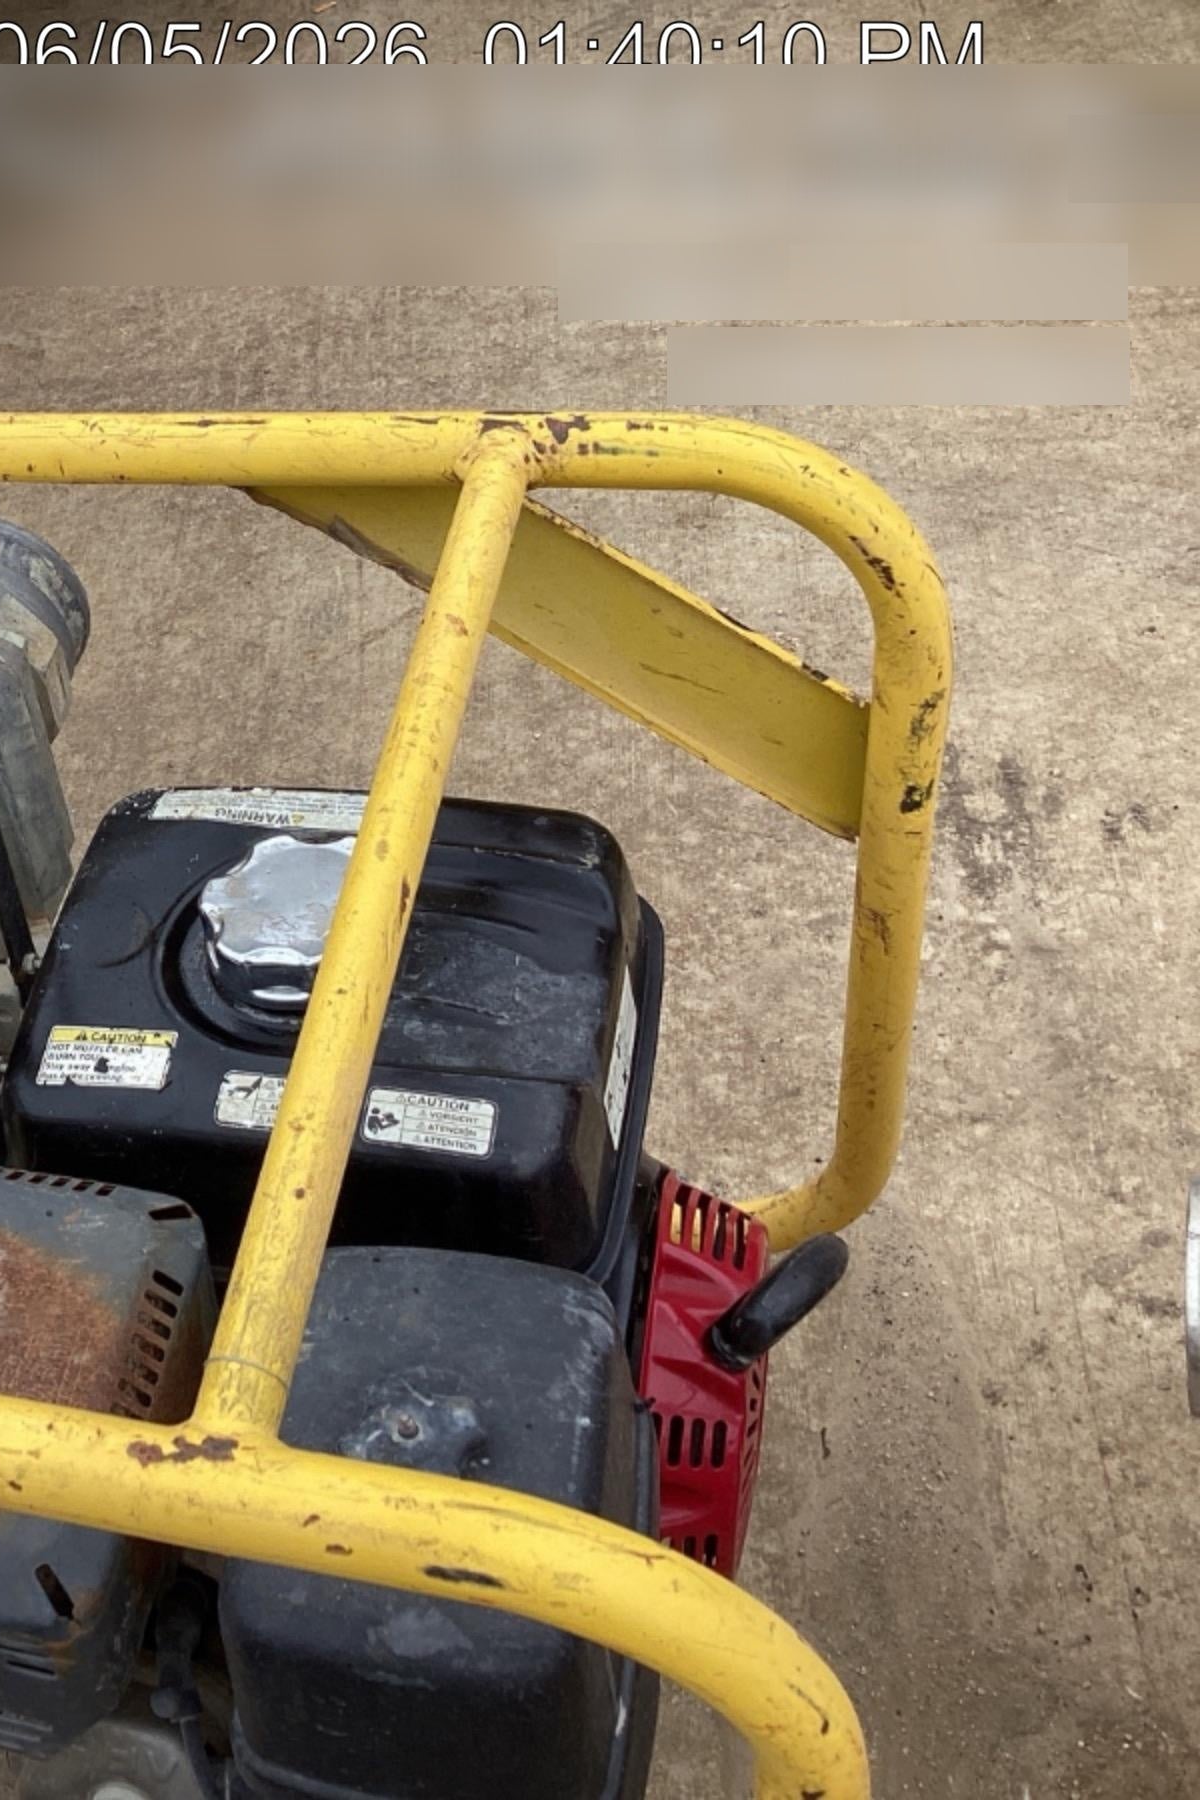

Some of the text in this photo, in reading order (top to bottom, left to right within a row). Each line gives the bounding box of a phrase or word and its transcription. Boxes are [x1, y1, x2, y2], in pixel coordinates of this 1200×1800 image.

[215, 807, 290, 825] WARNING
[91, 1032, 147, 1043] CAUTION
[407, 1095, 470, 1112] CAUTION
[423, 1135, 478, 1151] ATTENTION
